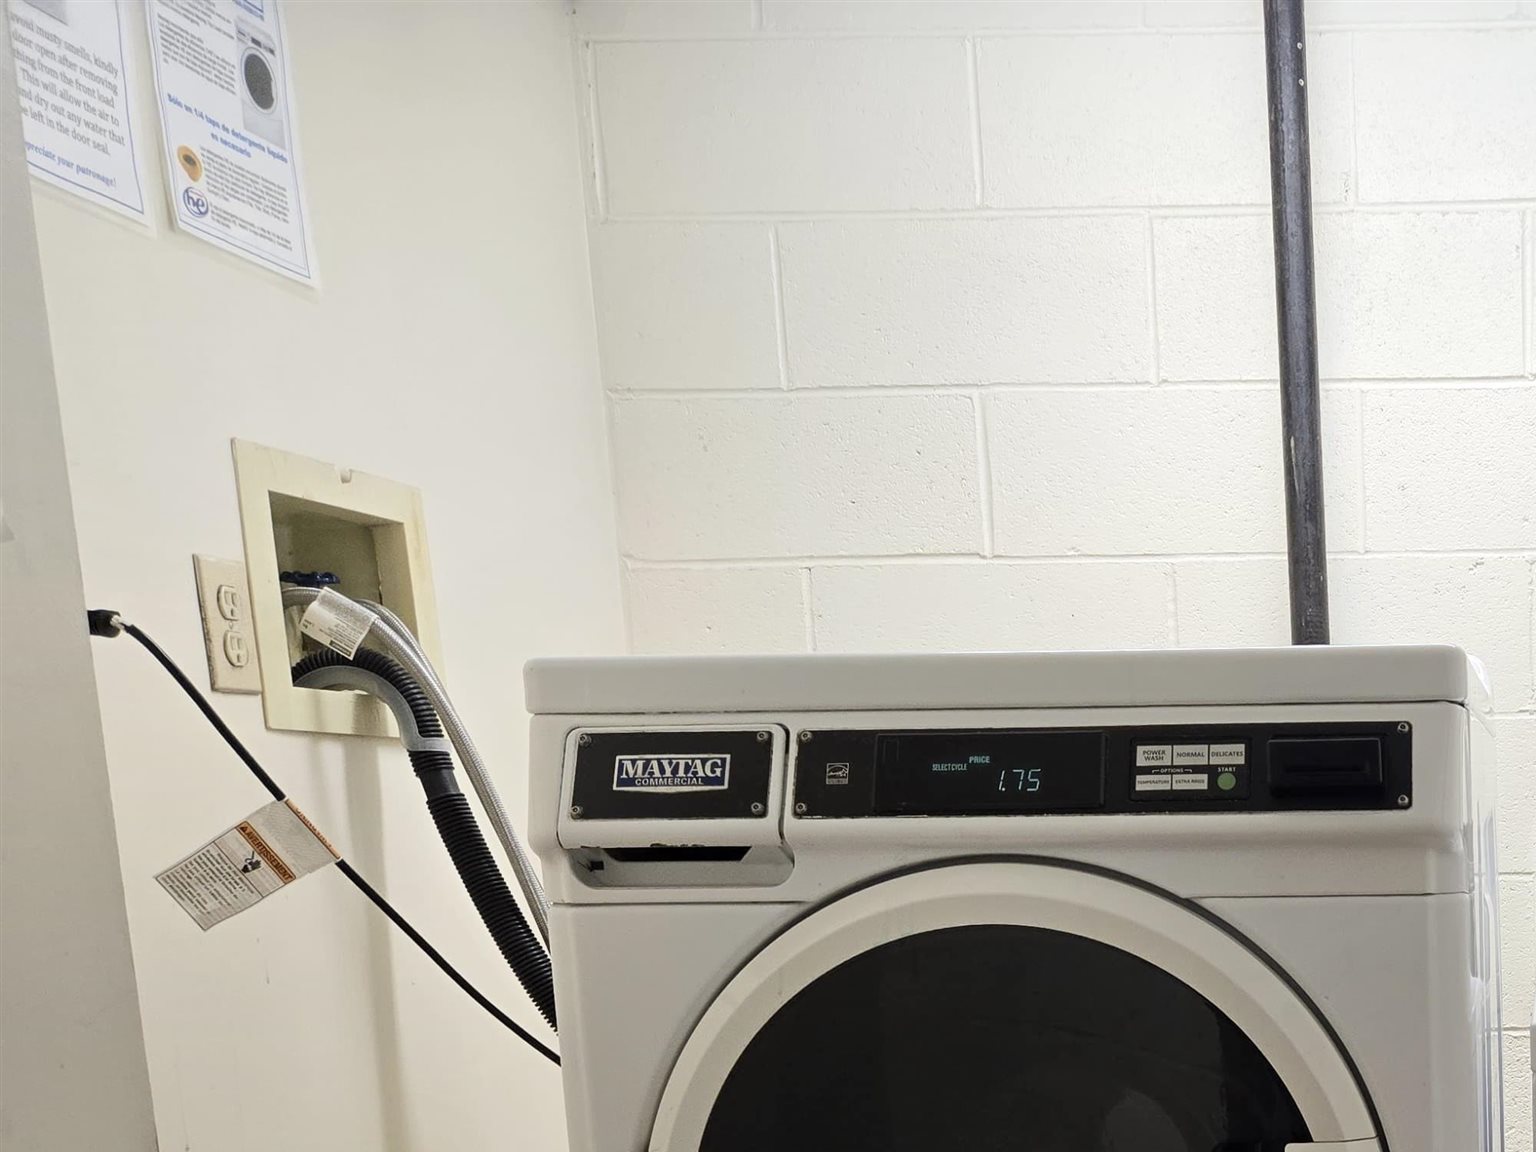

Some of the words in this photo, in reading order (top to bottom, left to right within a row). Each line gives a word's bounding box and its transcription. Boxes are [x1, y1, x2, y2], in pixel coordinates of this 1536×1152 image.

[13, 29, 33, 49] door
[35, 43, 56, 60] open
[59, 53, 78, 70] after
[80, 66, 118, 96] removing
[36, 24, 61, 48] musty
[93, 52, 118, 79] kindly
[21, 66, 39, 87] This
[41, 80, 58, 97] will
[60, 89, 81, 106] allow
[83, 101, 97, 116] the
[98, 109, 110, 122] air
[111, 114, 120, 127] to
[38, 59, 59, 79] from
[60, 71, 75, 87] the
[76, 79, 96, 99] front
[97, 88, 115, 108] load
[30, 106, 45, 125] left
[46, 114, 55, 129] in
[56, 121, 70, 137] the
[71, 129, 90, 146] door
[35, 94, 49, 111] dry
[51, 104, 66, 117] out
[67, 111, 82, 127] any
[83, 119, 107, 137] water
[108, 128, 125, 146] that
[57, 155, 75, 170] your
[76, 163, 117, 188] patronage!
[620, 759, 722, 778] MAYTAG
[932, 763, 951, 771] SELECT
[951, 763, 967, 771] CYCLE
[969, 756, 990, 764] PRICE
[998, 769, 1042, 791] 1.75
[635, 777, 704, 786] COMMERCIAL
[246, 830, 293, 882] AVERTISSEMENT
